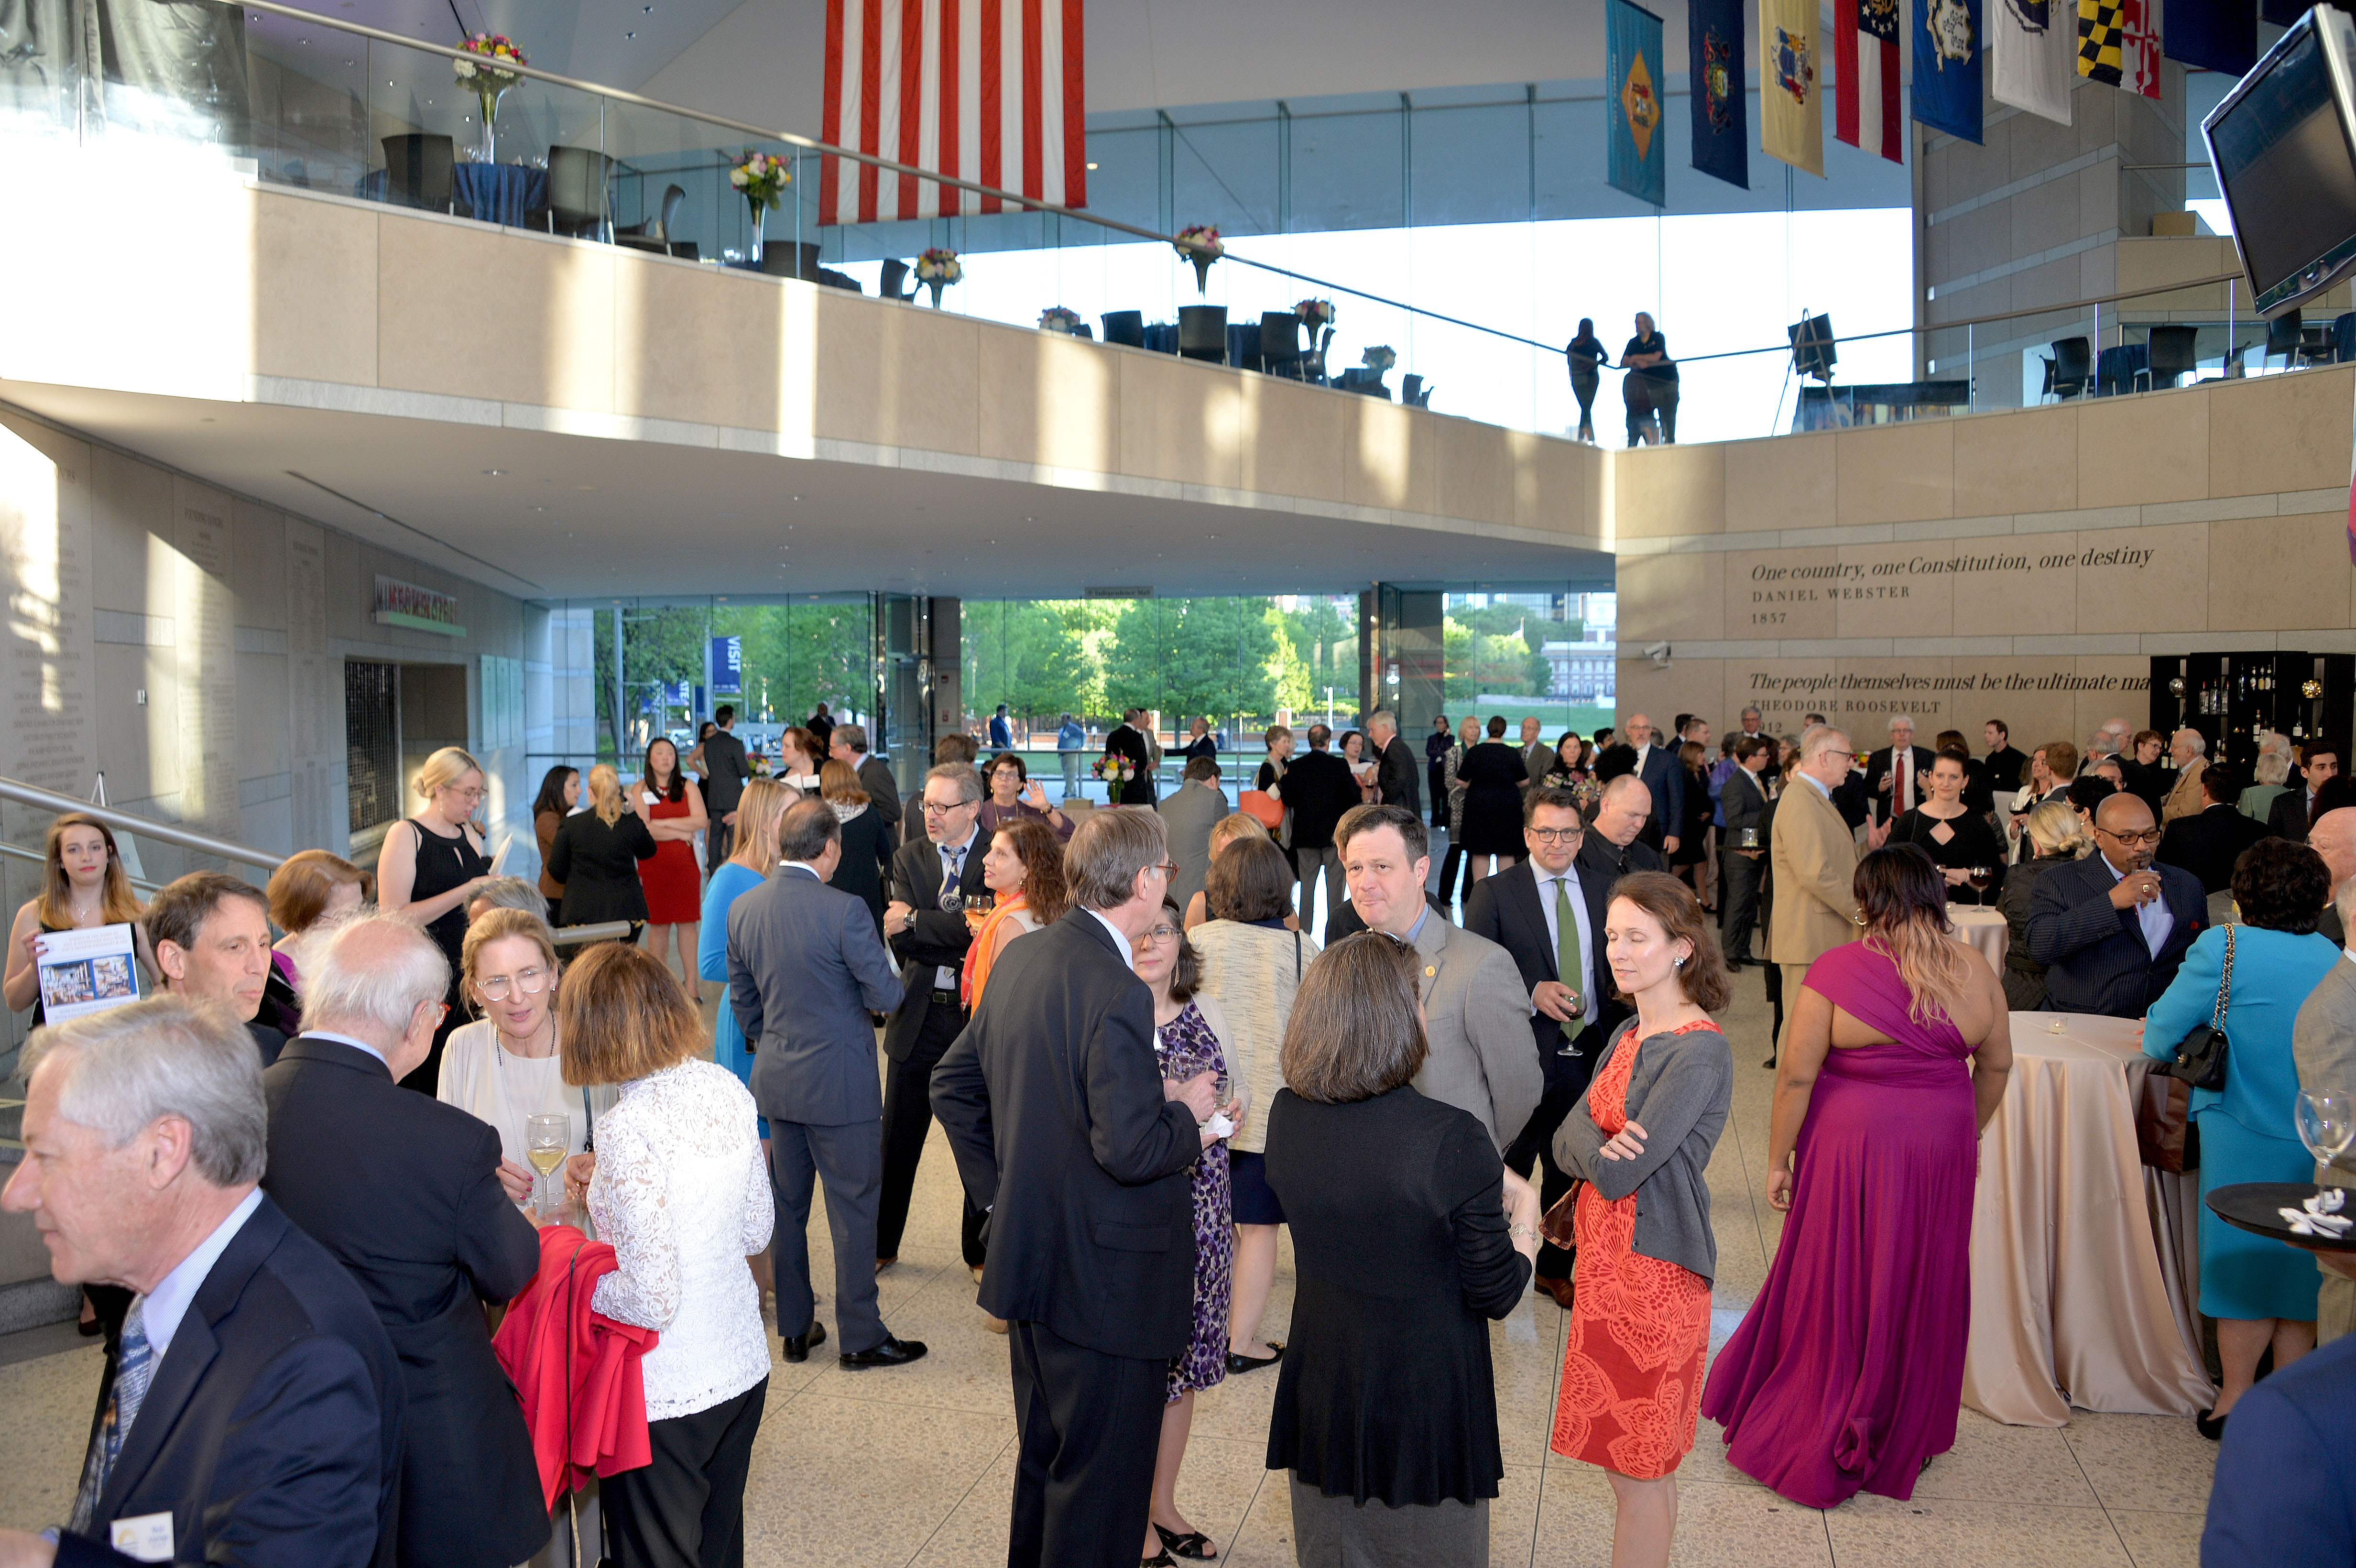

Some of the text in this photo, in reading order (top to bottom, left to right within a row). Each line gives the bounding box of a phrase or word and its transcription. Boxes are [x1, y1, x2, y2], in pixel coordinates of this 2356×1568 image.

[1752, 546, 2155, 581] One country, one Constitution, one destiny
[1753, 586, 1910, 603] DANIEL WEBSTER
[727, 635, 741, 674] VISIT
[1750, 673, 1781, 689] The
[1781, 672, 1837, 694] people
[1840, 672, 1931, 690] themselves
[1932, 674, 1976, 690] must
[1980, 672, 2002, 690] be
[2005, 672, 2035, 690] the
[2037, 672, 2117, 690] ultimate
[1750, 699, 1942, 713] THEODORE ROOSEVELT
